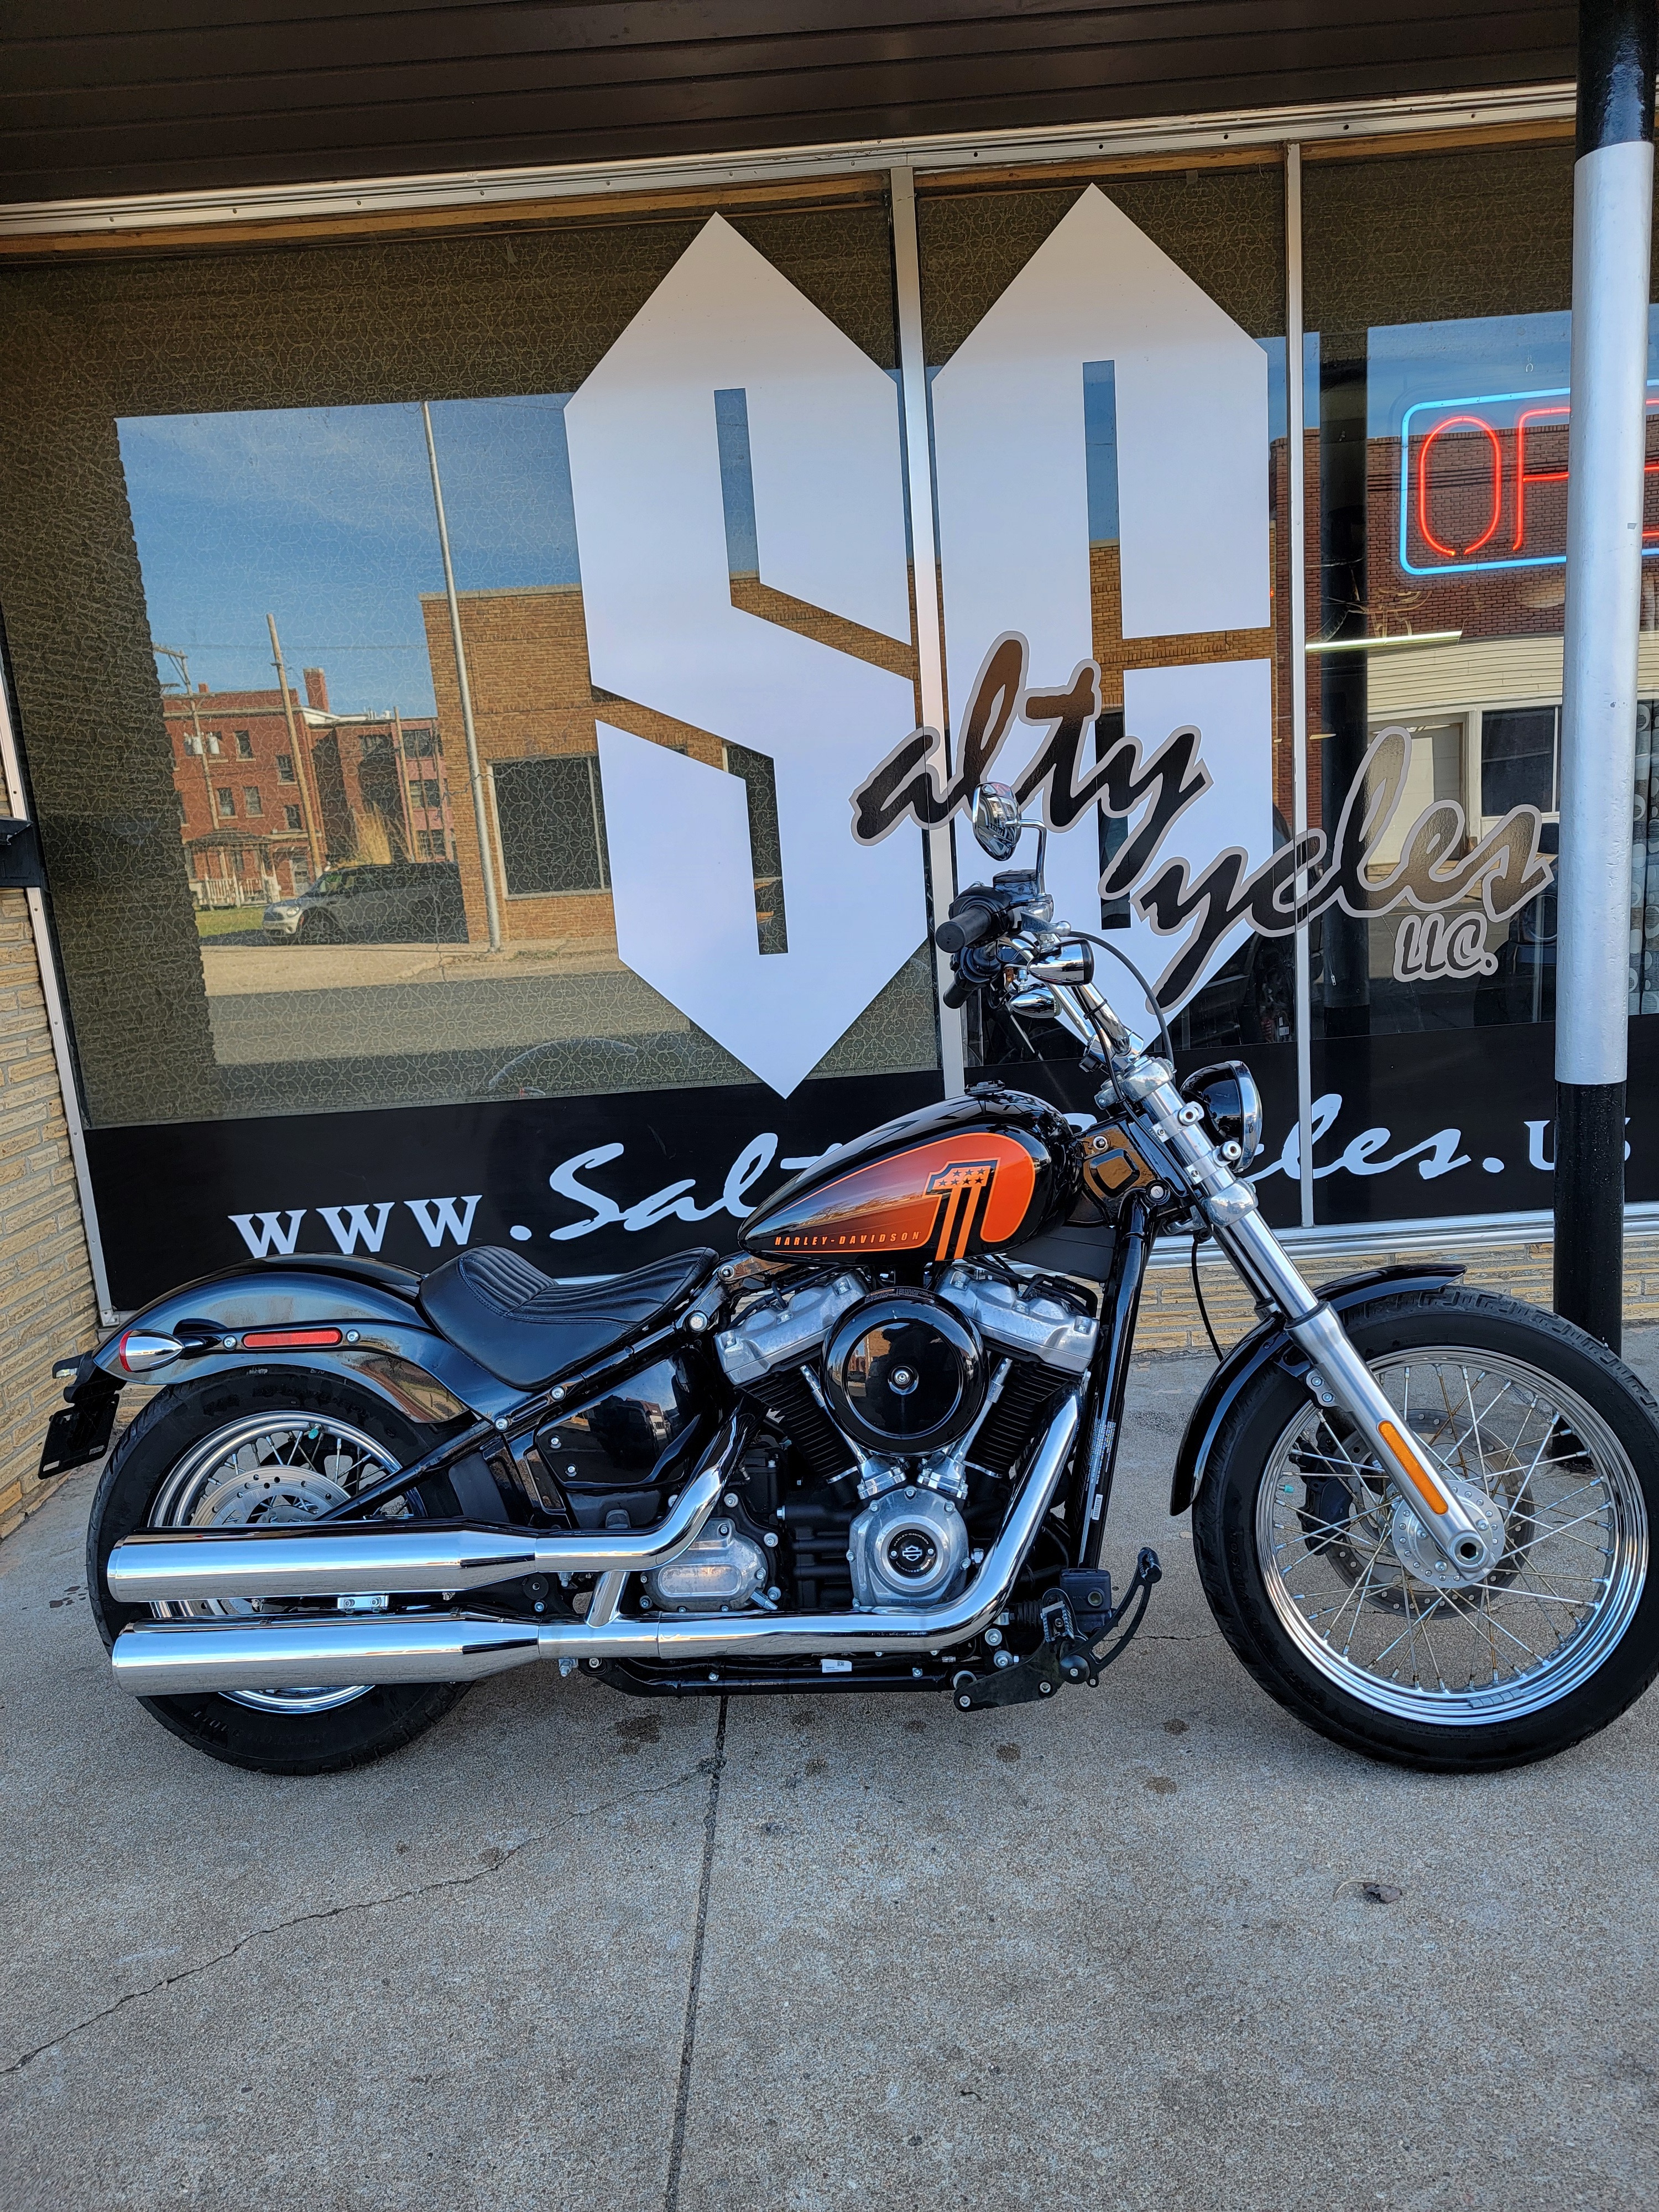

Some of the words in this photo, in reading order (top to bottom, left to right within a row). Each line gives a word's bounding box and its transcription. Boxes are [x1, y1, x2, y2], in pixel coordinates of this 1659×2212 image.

[1418, 399, 1659, 555] OP
[775, 1232, 920, 1246] HARLEY-DAVIDSON
[893, 1532, 930, 1547] HARLEY-DAVIDSON
